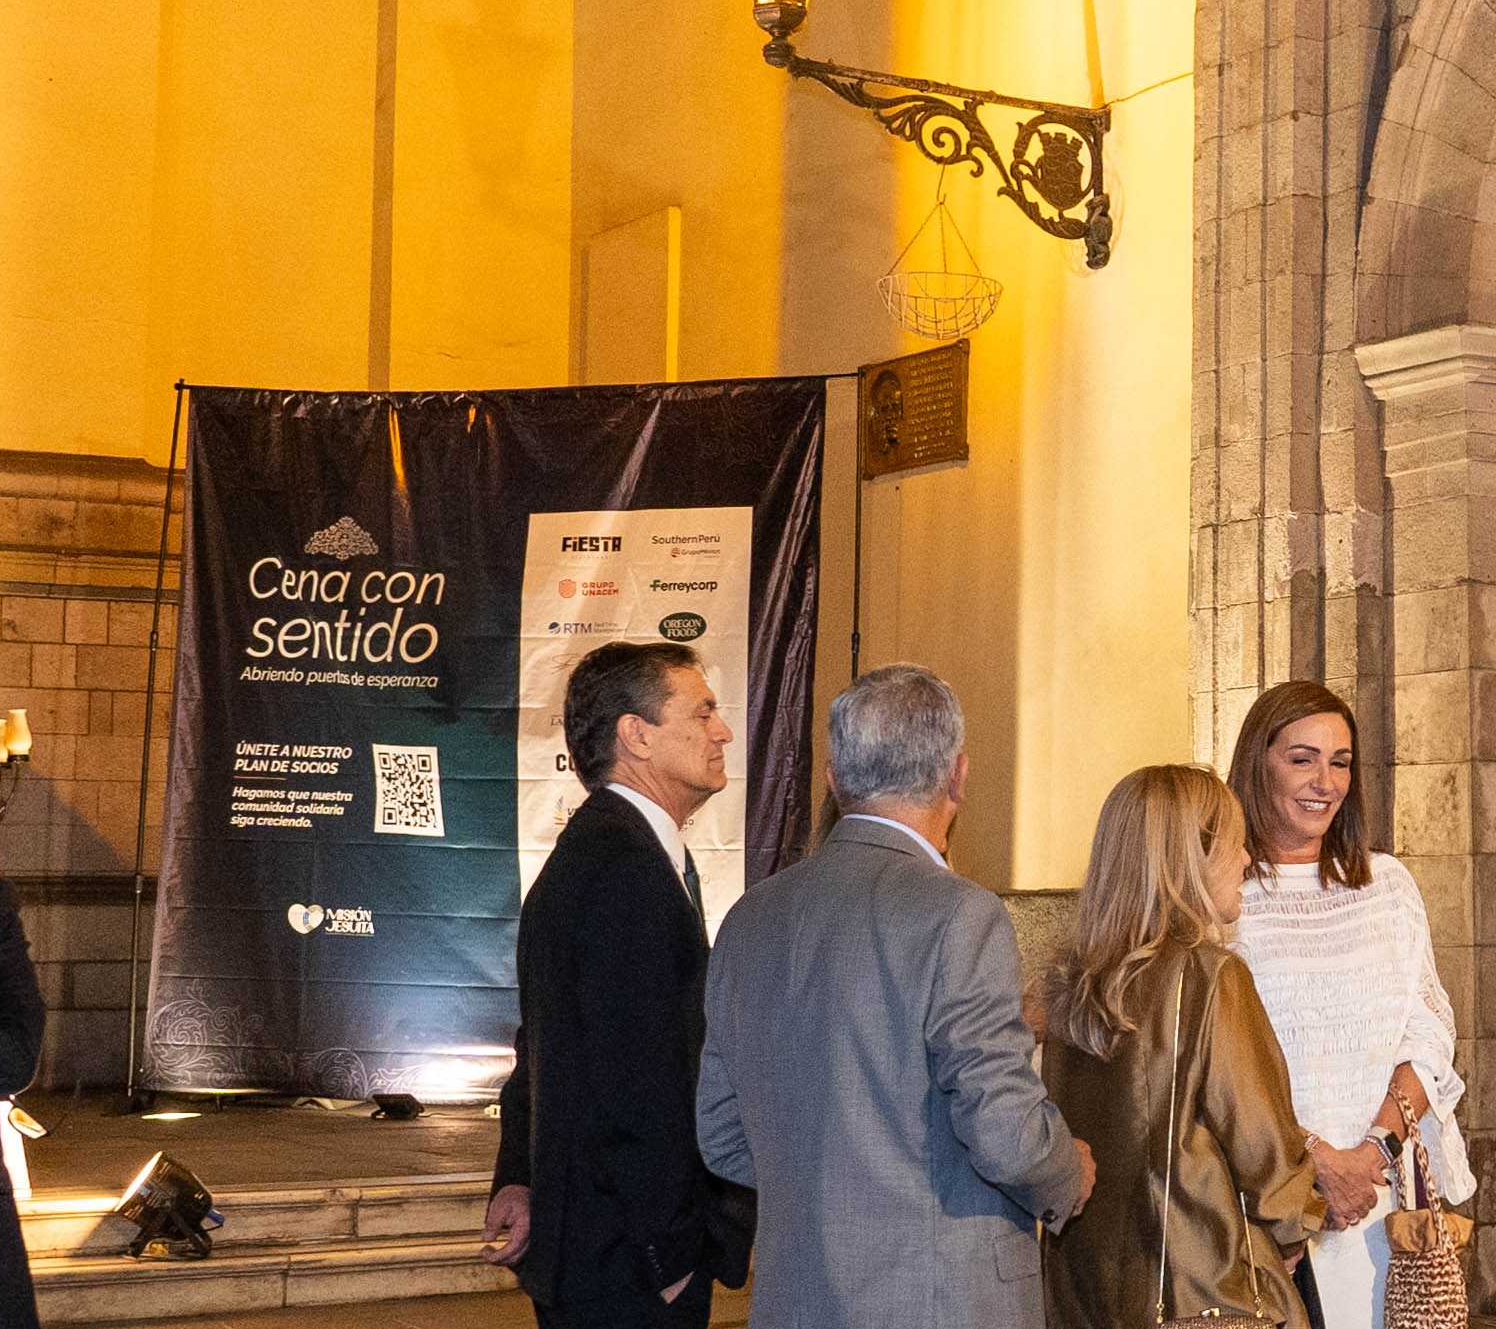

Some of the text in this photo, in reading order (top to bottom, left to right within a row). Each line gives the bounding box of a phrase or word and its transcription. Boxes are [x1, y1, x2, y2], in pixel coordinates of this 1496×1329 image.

[249, 557, 445, 605] Cena con
[582, 581, 614, 589] GRUPO
[650, 579, 718, 593] Ferreycorp
[564, 622, 592, 634] RTM
[664, 619, 702, 629] OREGON
[246, 607, 438, 663] sentido
[667, 628, 698, 638] FOODS
[240, 666, 304, 683] Abriendo
[351, 672, 365, 687] de
[367, 675, 439, 690] esperanza
[236, 740, 353, 760] ÚNETE A NUESTRO
[235, 759, 339, 775] PLAN DE SOCIOS
[232, 786, 353, 802] Hagamos que nuestra
[232, 801, 345, 816] comunidad solidaria
[230, 814, 313, 828] siga creciendo.
[325, 906, 372, 922] MISIÓN
[325, 921, 375, 934] JESUITA
